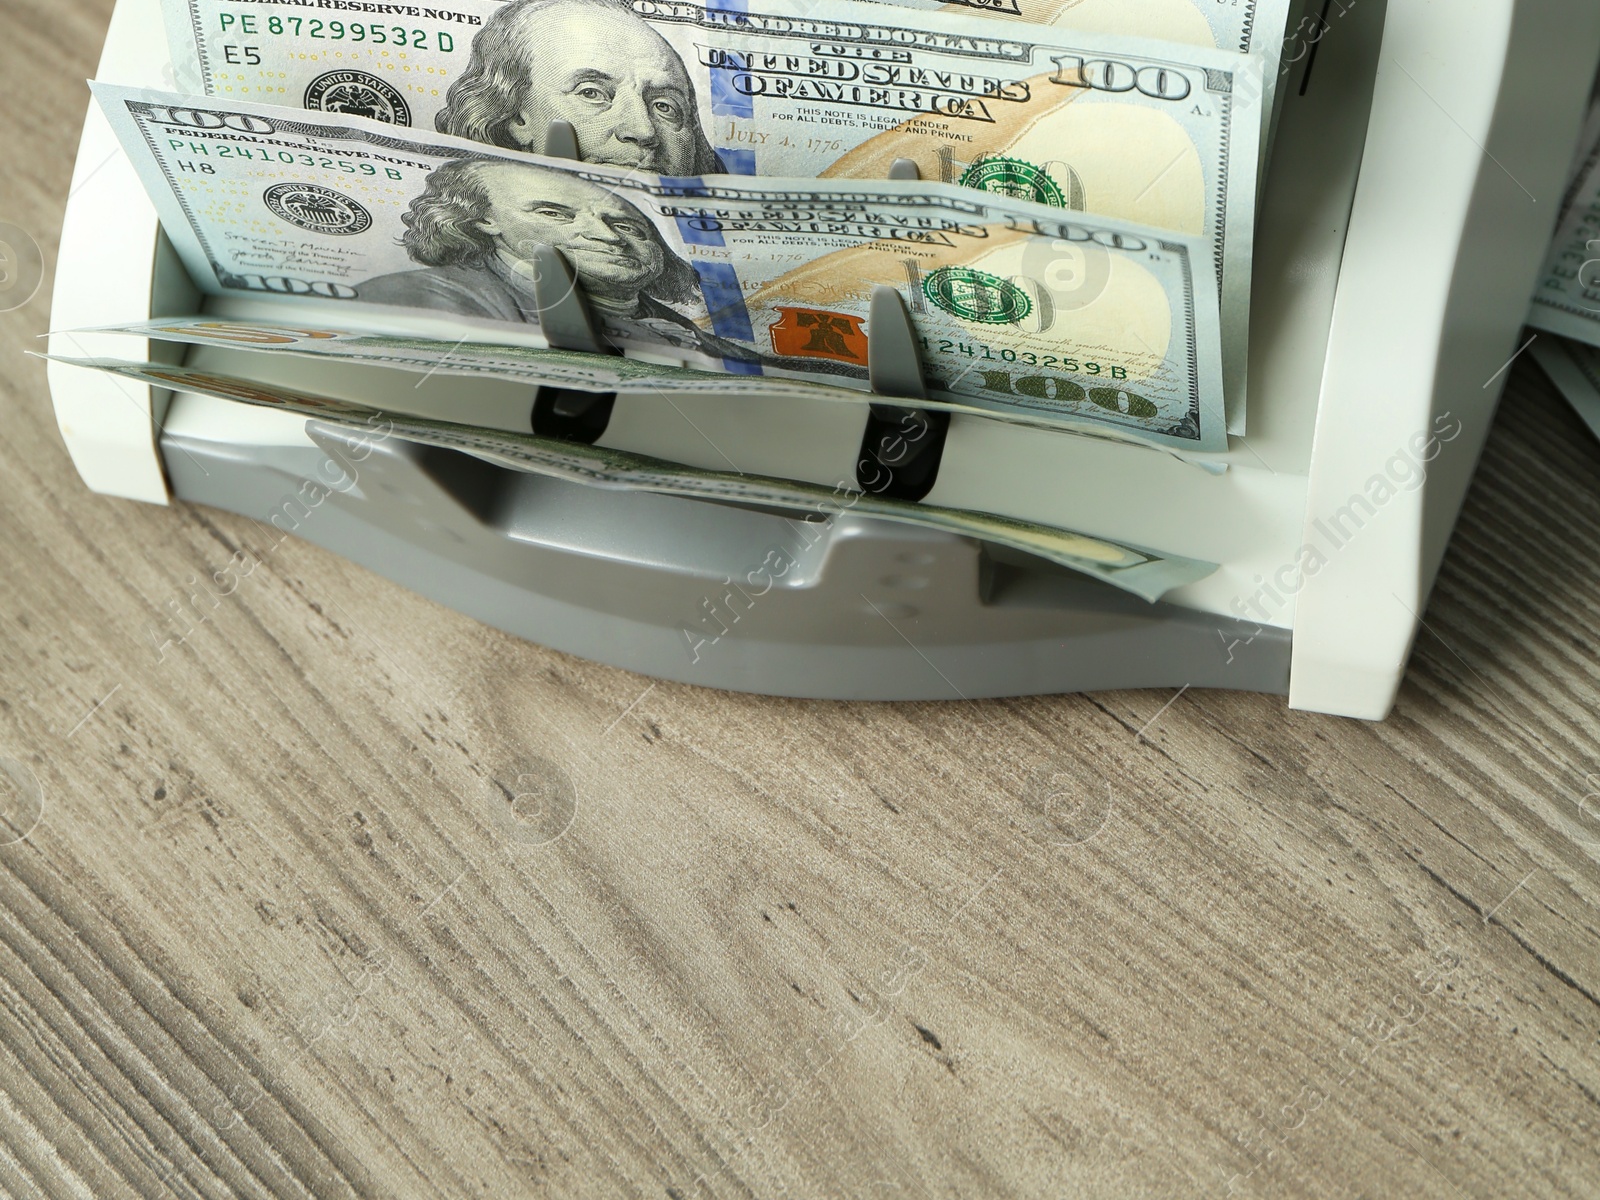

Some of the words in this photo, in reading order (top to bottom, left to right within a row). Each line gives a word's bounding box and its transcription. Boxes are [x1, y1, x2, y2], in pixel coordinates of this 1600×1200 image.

[316, 0, 419, 17] RESERVE
[424, 8, 482, 26] NOTE
[220, 13, 258, 34] PE
[268, 16, 427, 51] 87299532
[438, 31, 454, 53] D
[632, 0, 696, 19] ONE
[703, 7, 862, 40] HUNDRED
[866, 30, 1024, 58] DOLLARS
[225, 45, 261, 65] E5
[810, 43, 912, 63] THE
[315, 73, 353, 92] UNITED
[357, 74, 394, 99] STATES
[694, 43, 859, 81] UNITED
[862, 61, 1031, 103] STATES
[1049, 55, 1191, 101] 100
[732, 73, 793, 97] OF
[788, 75, 996, 123] AMERICA
[1190, 105, 1203, 116] A
[147, 107, 275, 134] 100
[772, 112, 793, 121] FOR
[797, 114, 817, 124] ALL
[821, 117, 858, 129] DEBTS,
[862, 121, 902, 132] PUBLIC
[905, 126, 928, 136] AND
[931, 129, 973, 143] PRIVATE
[796, 107, 821, 116] THIS
[824, 109, 853, 119] NOTE
[856, 112, 867, 120] IS
[870, 114, 903, 125] LEGAL
[907, 118, 949, 131] TENDER
[164, 128, 260, 143] FEDERAL
[265, 137, 369, 159] RESERVE
[373, 153, 432, 171] NOTE
[168, 139, 208, 156] PH
[216, 145, 377, 176] 24103259
[385, 167, 403, 181] B
[177, 160, 215, 175] H8
[274, 183, 309, 197] UNITED
[312, 185, 350, 205] STATES
[305, 222, 351, 234] RESERVE
[1003, 214, 1147, 251] 100
[830, 238, 864, 246] LEGAL
[893, 249, 937, 258] PRIVATE
[246, 274, 359, 300] 100
[939, 339, 1101, 376] 24103259
[1111, 365, 1128, 380] B
[973, 369, 1158, 419] 100
